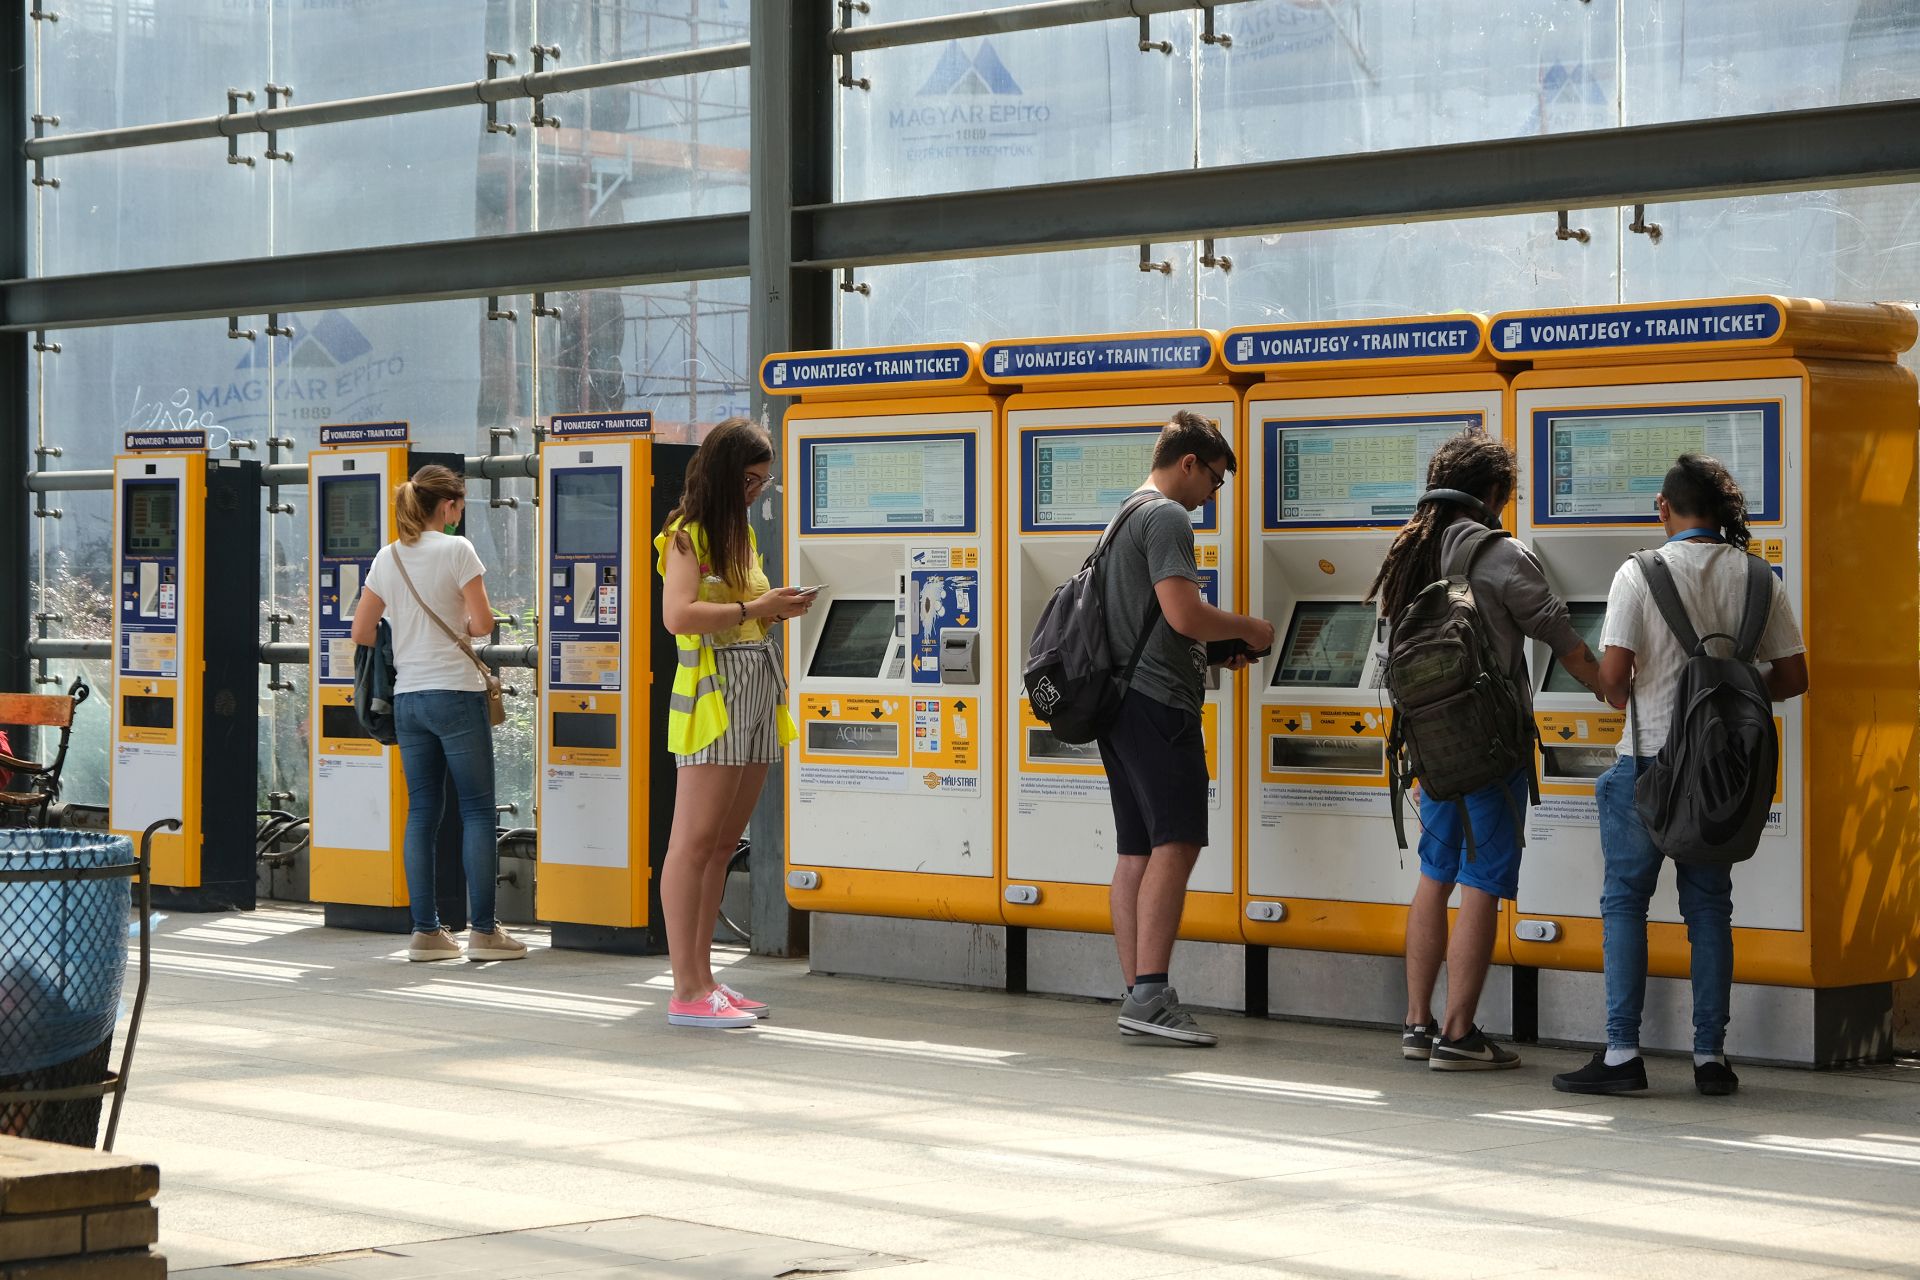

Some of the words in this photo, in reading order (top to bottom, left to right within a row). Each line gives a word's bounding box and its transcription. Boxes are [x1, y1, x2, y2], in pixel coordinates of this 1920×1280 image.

[889, 105, 983, 128] MAGYAR
[1531, 320, 1631, 343] VONATJEGY
[1645, 317, 1698, 337] TRAIN
[1702, 314, 1765, 334] TICKET
[1261, 336, 1349, 356] VONATJEGY
[1362, 332, 1408, 350] TRAIN
[1413, 330, 1467, 348] TICKET
[1016, 350, 1095, 368] VONATJEGY
[1106, 348, 1148, 364] TRAIN
[1152, 346, 1200, 362] TICKET
[793, 362, 864, 380] VONATJEGY
[875, 359, 915, 376] TRAIN
[916, 357, 960, 374] TICKET
[196, 378, 328, 410] MAGYAR
[292, 406, 332, 420] 1889
[563, 420, 600, 430] VONATJEGY
[605, 419, 624, 428] TRAIN
[625, 418, 648, 428] TICKET
[134, 436, 164, 446] VONATJEGY
[168, 436, 184, 446] TRAIN
[184, 435, 203, 445] TICKET
[330, 430, 362, 440] VONATJEGY
[367, 429, 385, 438] TRAIN
[385, 428, 405, 437] TICKET
[836, 726, 873, 746] AQUIS
